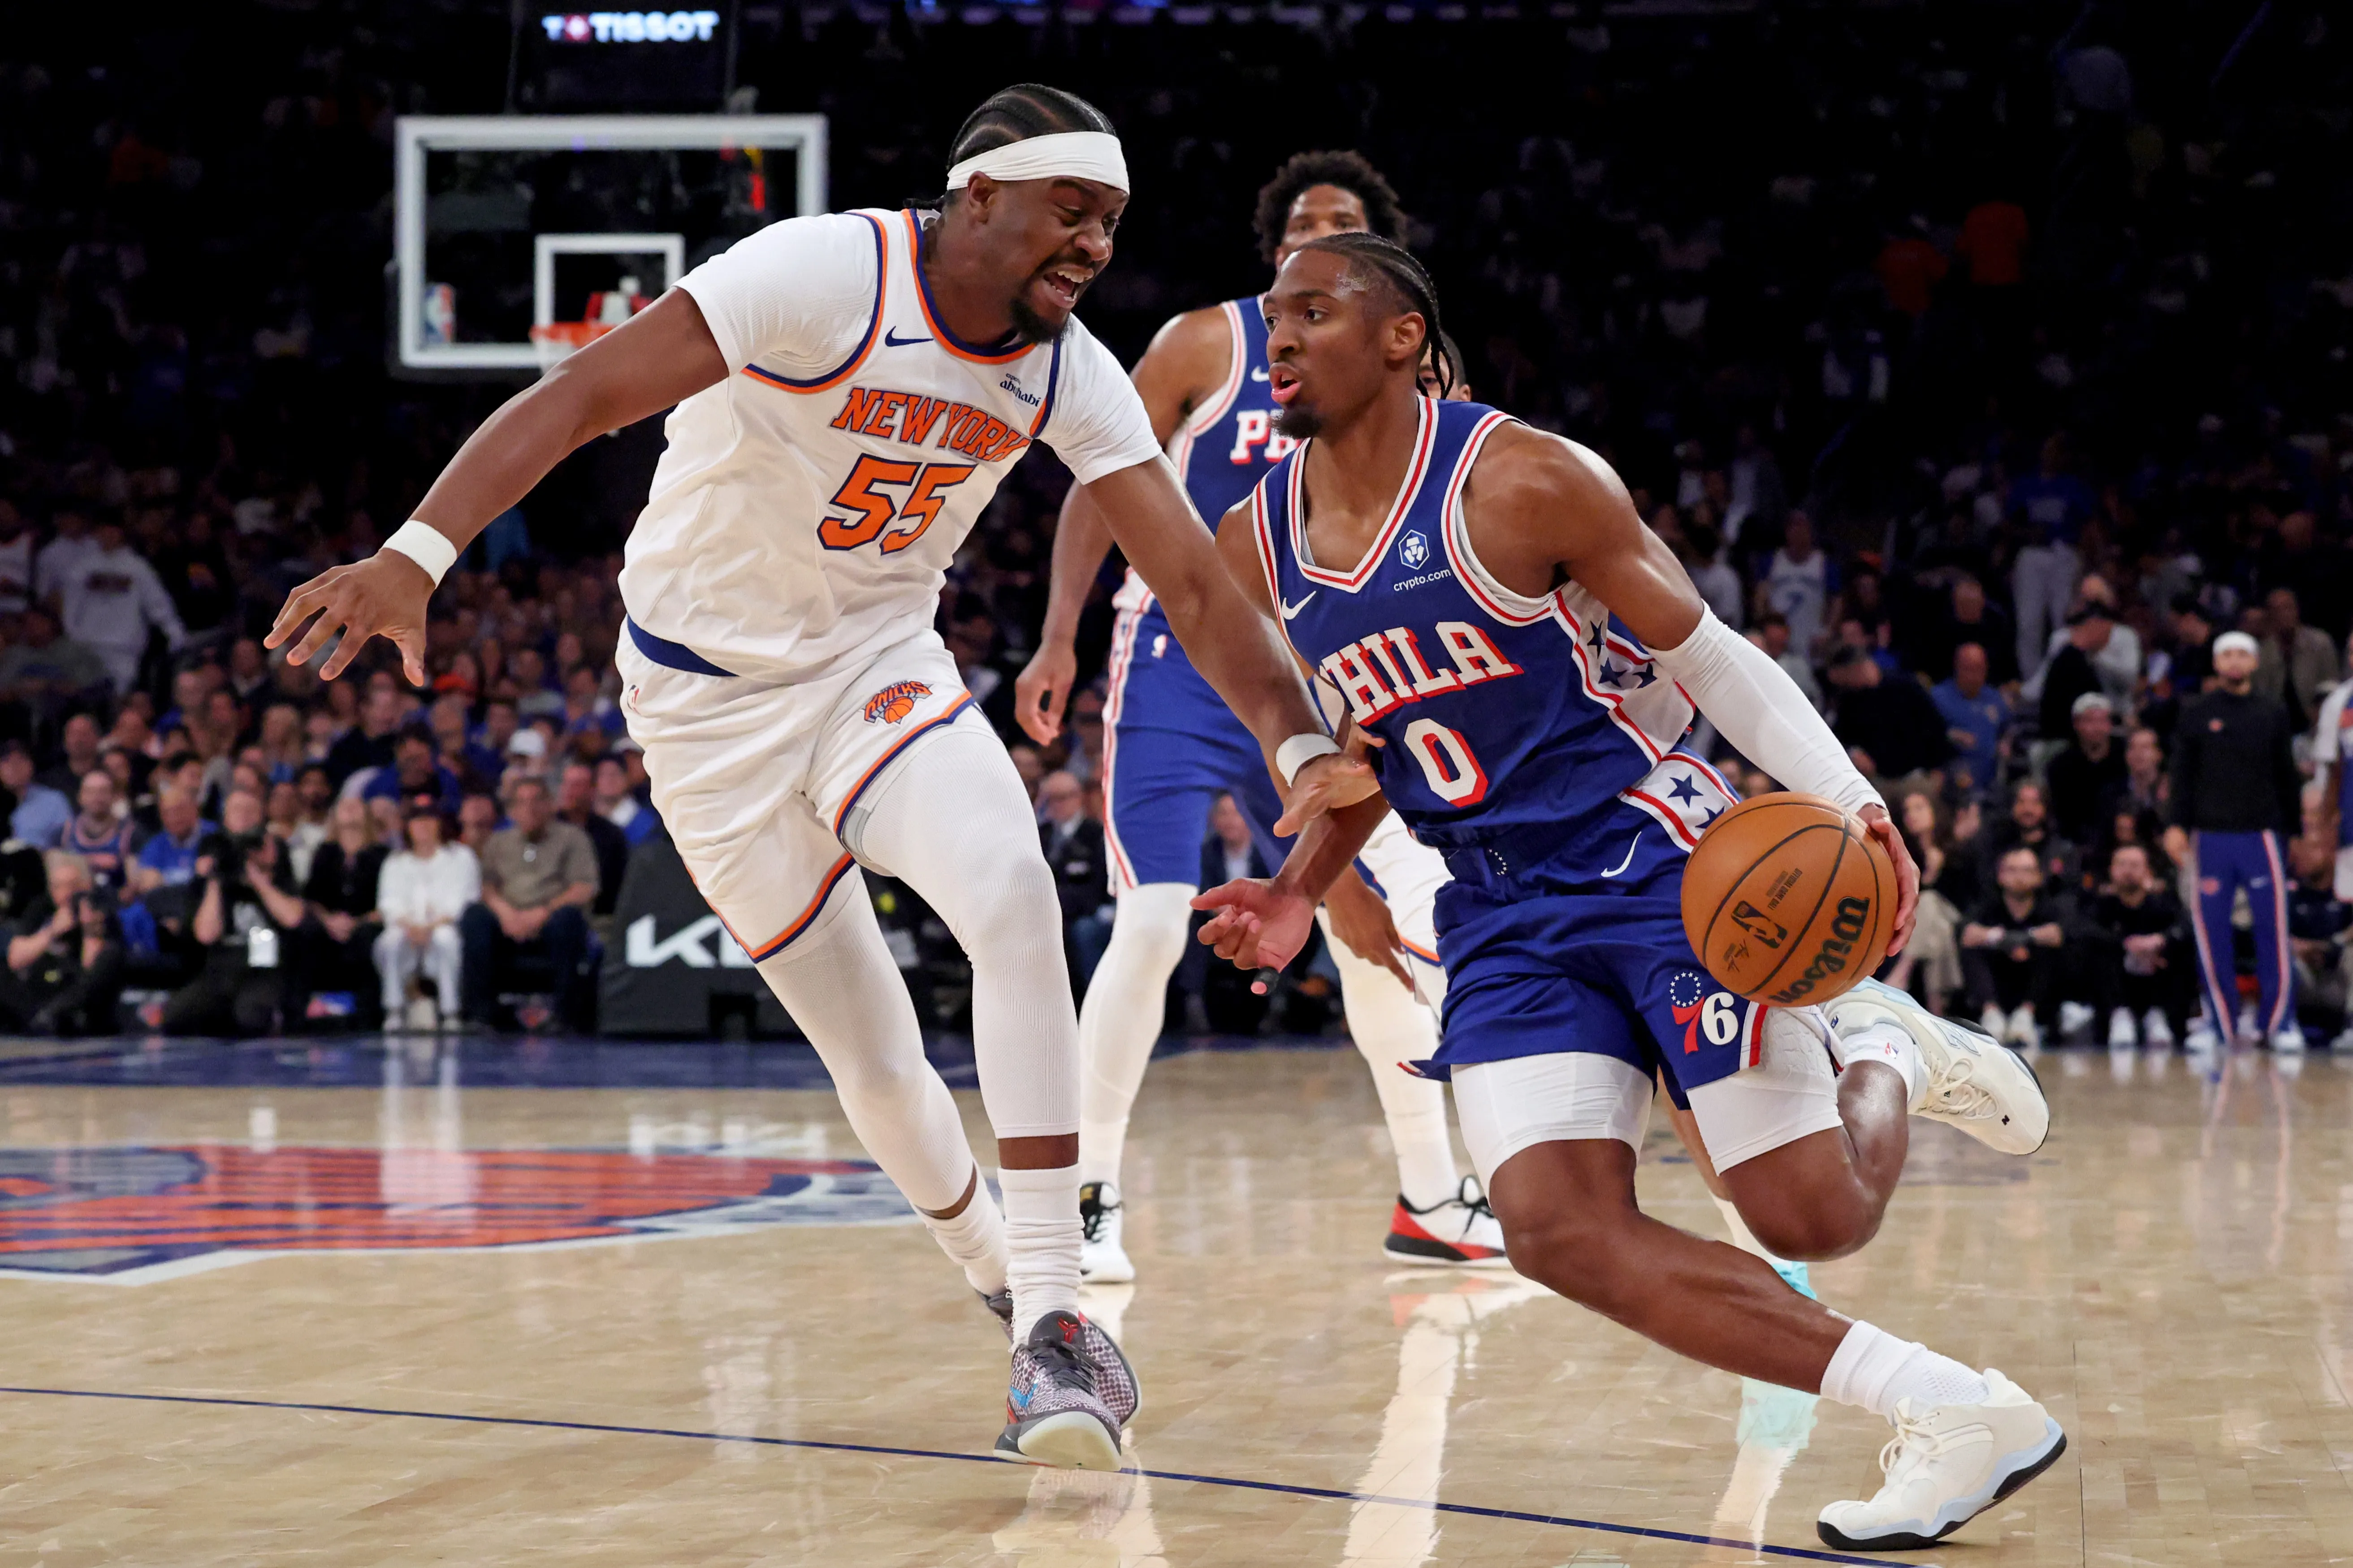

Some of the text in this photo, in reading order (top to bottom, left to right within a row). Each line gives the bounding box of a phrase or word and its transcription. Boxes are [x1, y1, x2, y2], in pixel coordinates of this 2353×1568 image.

[588, 11, 720, 43] TISSOT
[829, 386, 1032, 462] NEW YORK
[817, 453, 978, 556] 55
[1393, 569, 1451, 591] crypto.com
[864, 680, 933, 723] KNICKS
[1319, 621, 1524, 726] HILA
[1404, 718, 1488, 807] 0
[1671, 992, 1739, 1055] 76
